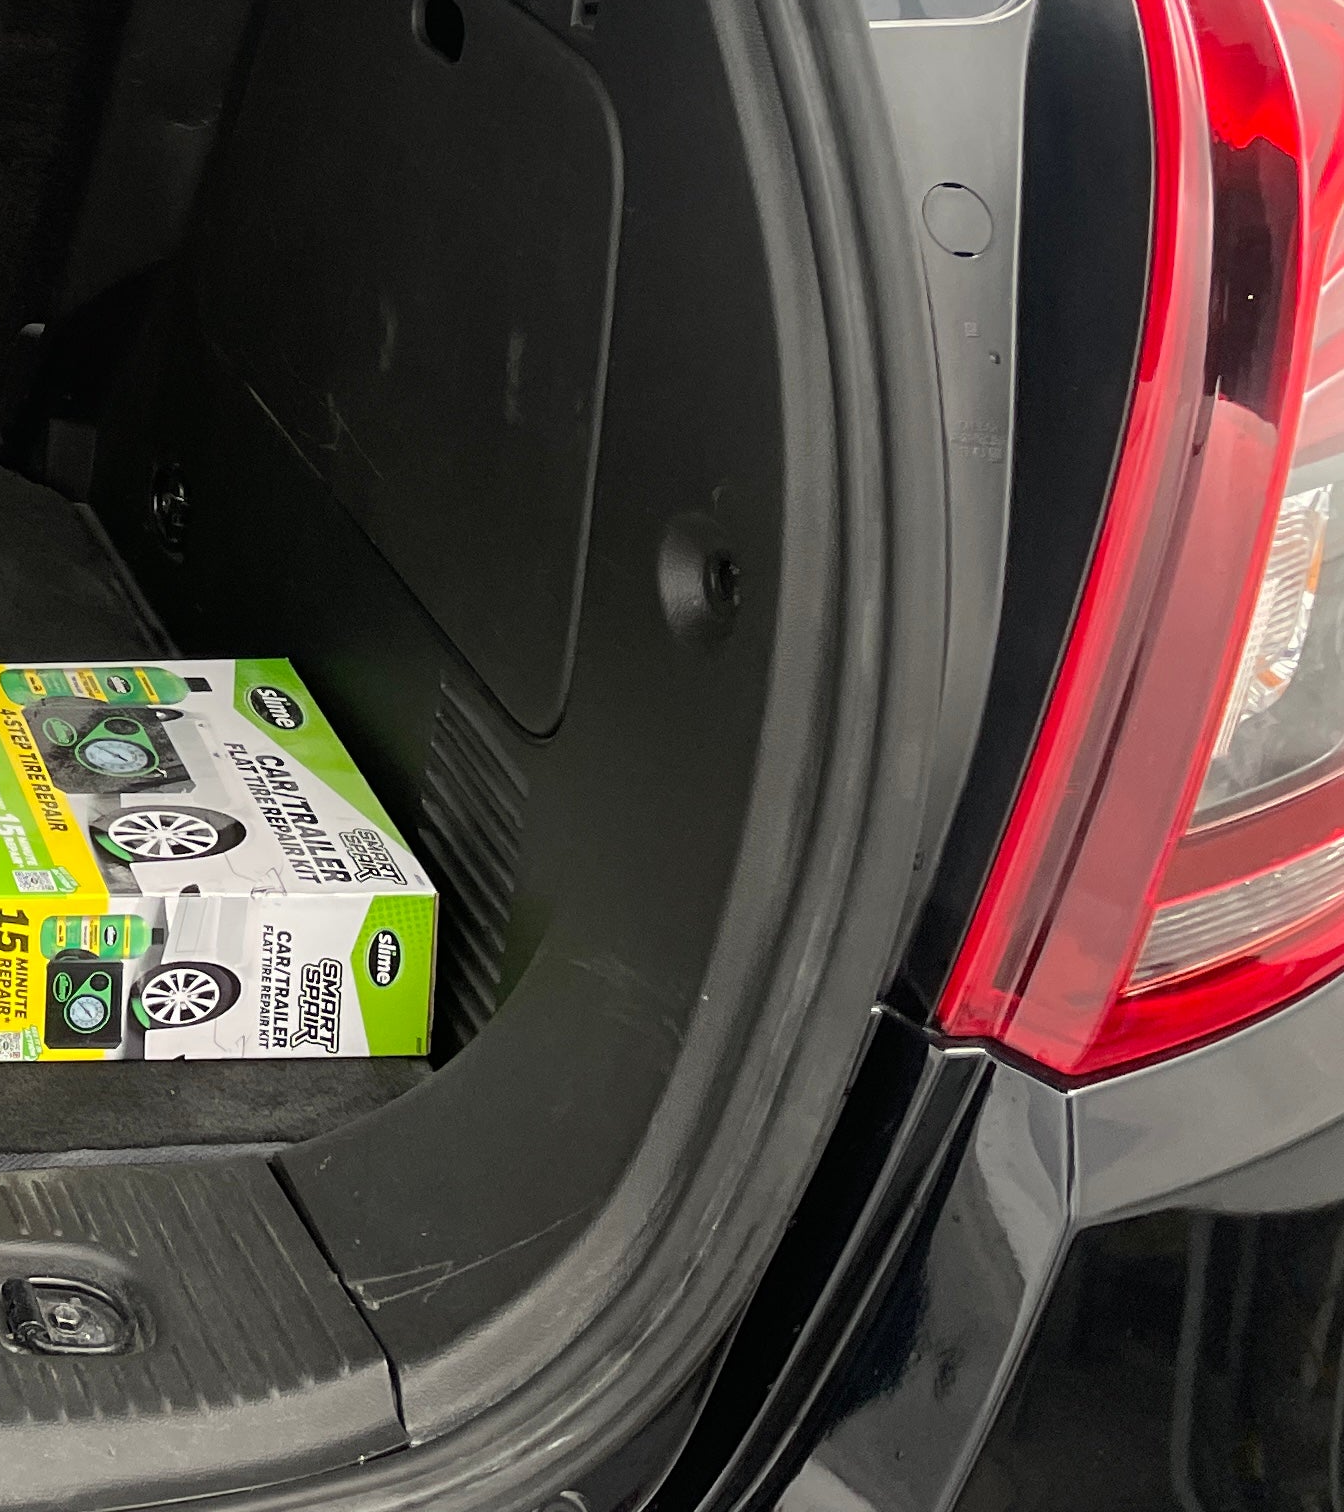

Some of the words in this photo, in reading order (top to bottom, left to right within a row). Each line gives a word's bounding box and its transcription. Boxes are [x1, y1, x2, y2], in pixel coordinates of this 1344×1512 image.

[0, 708, 32, 750] 4-STEP
[257, 687, 296, 729] slime
[19, 753, 46, 781] TIRE
[32, 783, 68, 831] REPAIR
[224, 742, 259, 775] FLAT
[244, 776, 276, 805] TIRE
[260, 804, 306, 859] REPAIR
[289, 858, 322, 884] KIT
[256, 755, 352, 882] CAR/TRAILER
[343, 833, 382, 883] SPAIR
[356, 828, 404, 884] SMART
[262, 924, 274, 954] FLAT
[377, 933, 397, 984] slime
[14, 956, 29, 1019] MINUTE
[261, 957, 273, 984] TIRE
[272, 930, 292, 1048] CAR/TRAILER
[259, 984, 271, 1027] REPAIR
[295, 966, 321, 1043] SPAIR
[319, 961, 338, 1050] SMART
[258, 1029, 269, 1049] KIT
